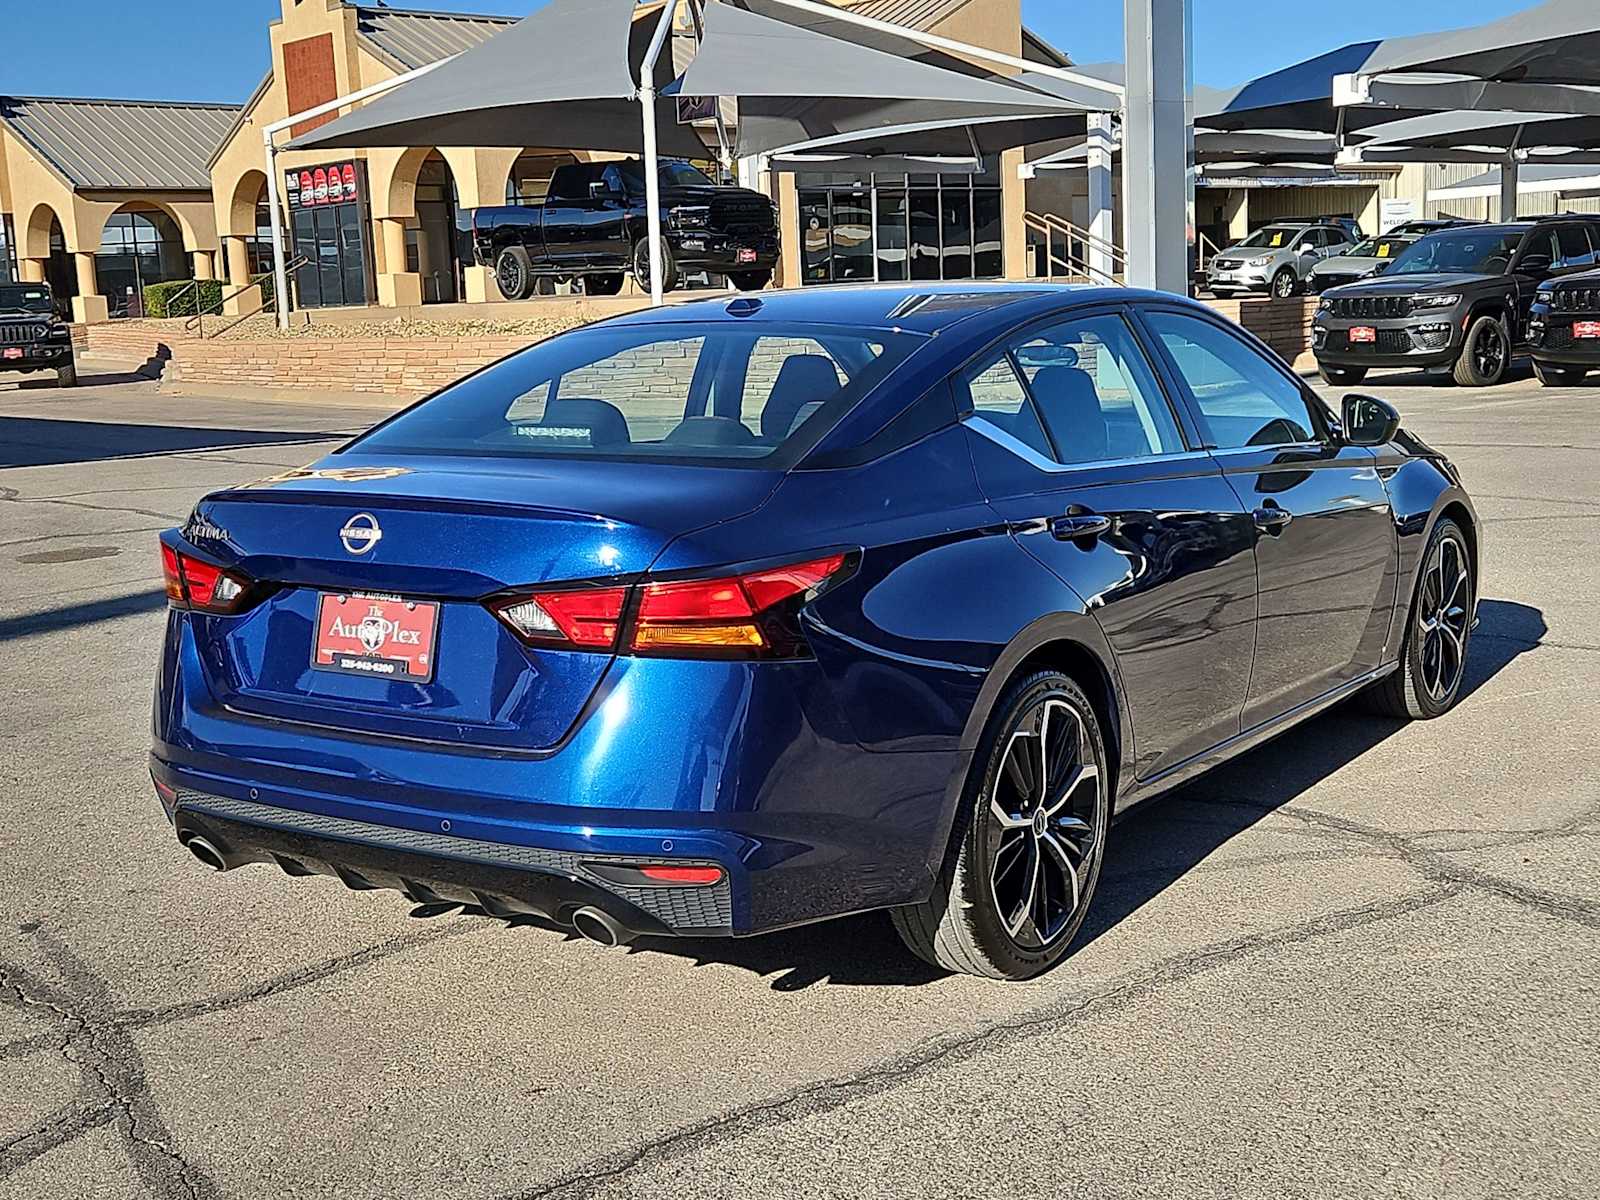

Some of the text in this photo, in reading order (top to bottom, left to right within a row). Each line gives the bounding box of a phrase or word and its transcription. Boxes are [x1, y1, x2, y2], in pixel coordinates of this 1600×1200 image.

[191, 525, 229, 540] ALTIMA
[340, 528, 381, 539] NISSA
[366, 592, 402, 602] AUTOPLEX
[368, 605, 383, 616] The
[328, 616, 421, 645] AutPlex
